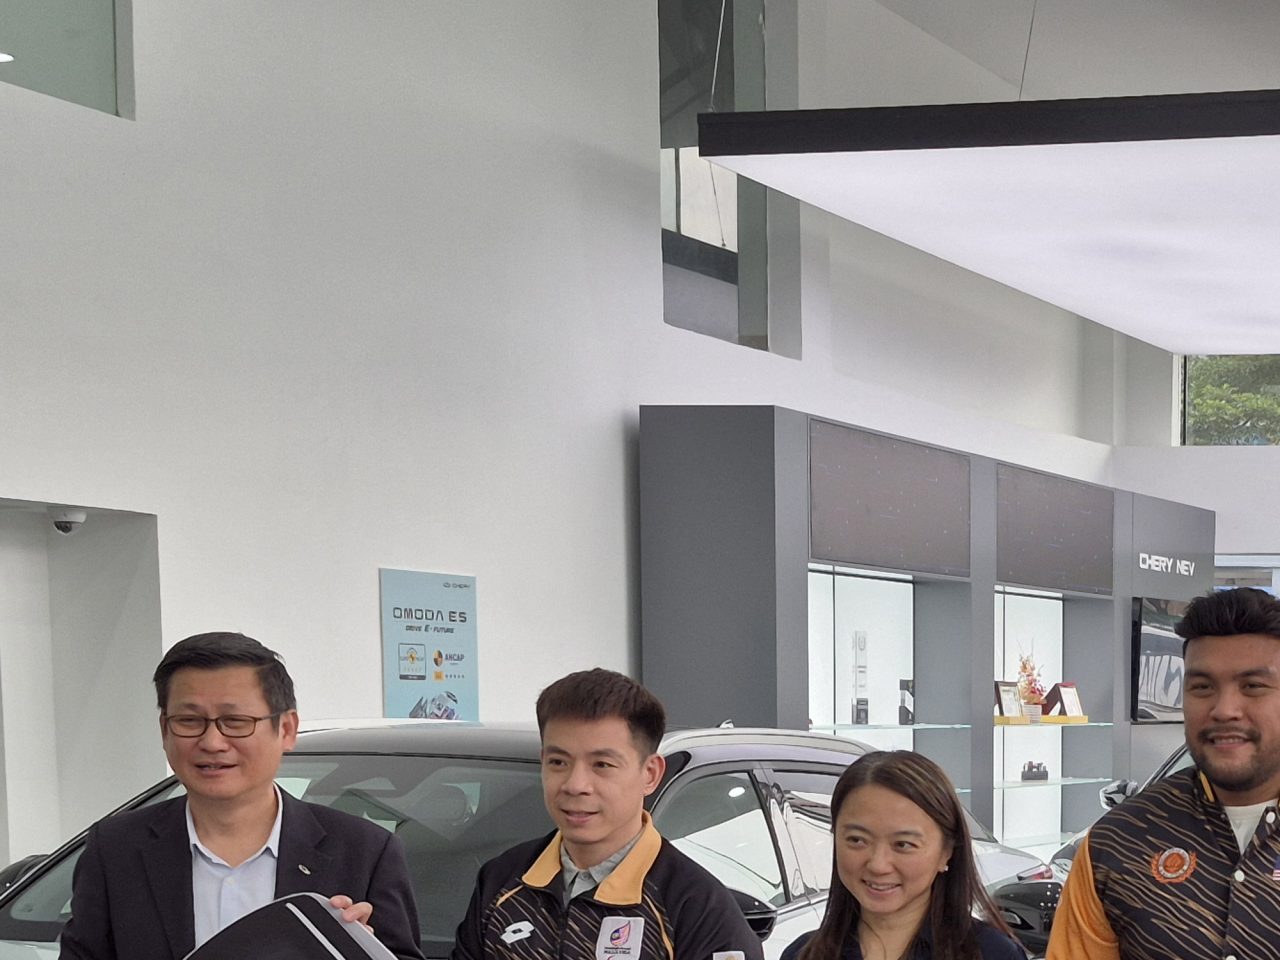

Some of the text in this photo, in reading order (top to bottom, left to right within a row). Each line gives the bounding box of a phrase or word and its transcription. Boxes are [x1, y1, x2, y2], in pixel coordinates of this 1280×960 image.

[1139, 552, 1195, 576] CHERY NEV
[393, 607, 444, 621] OMODA
